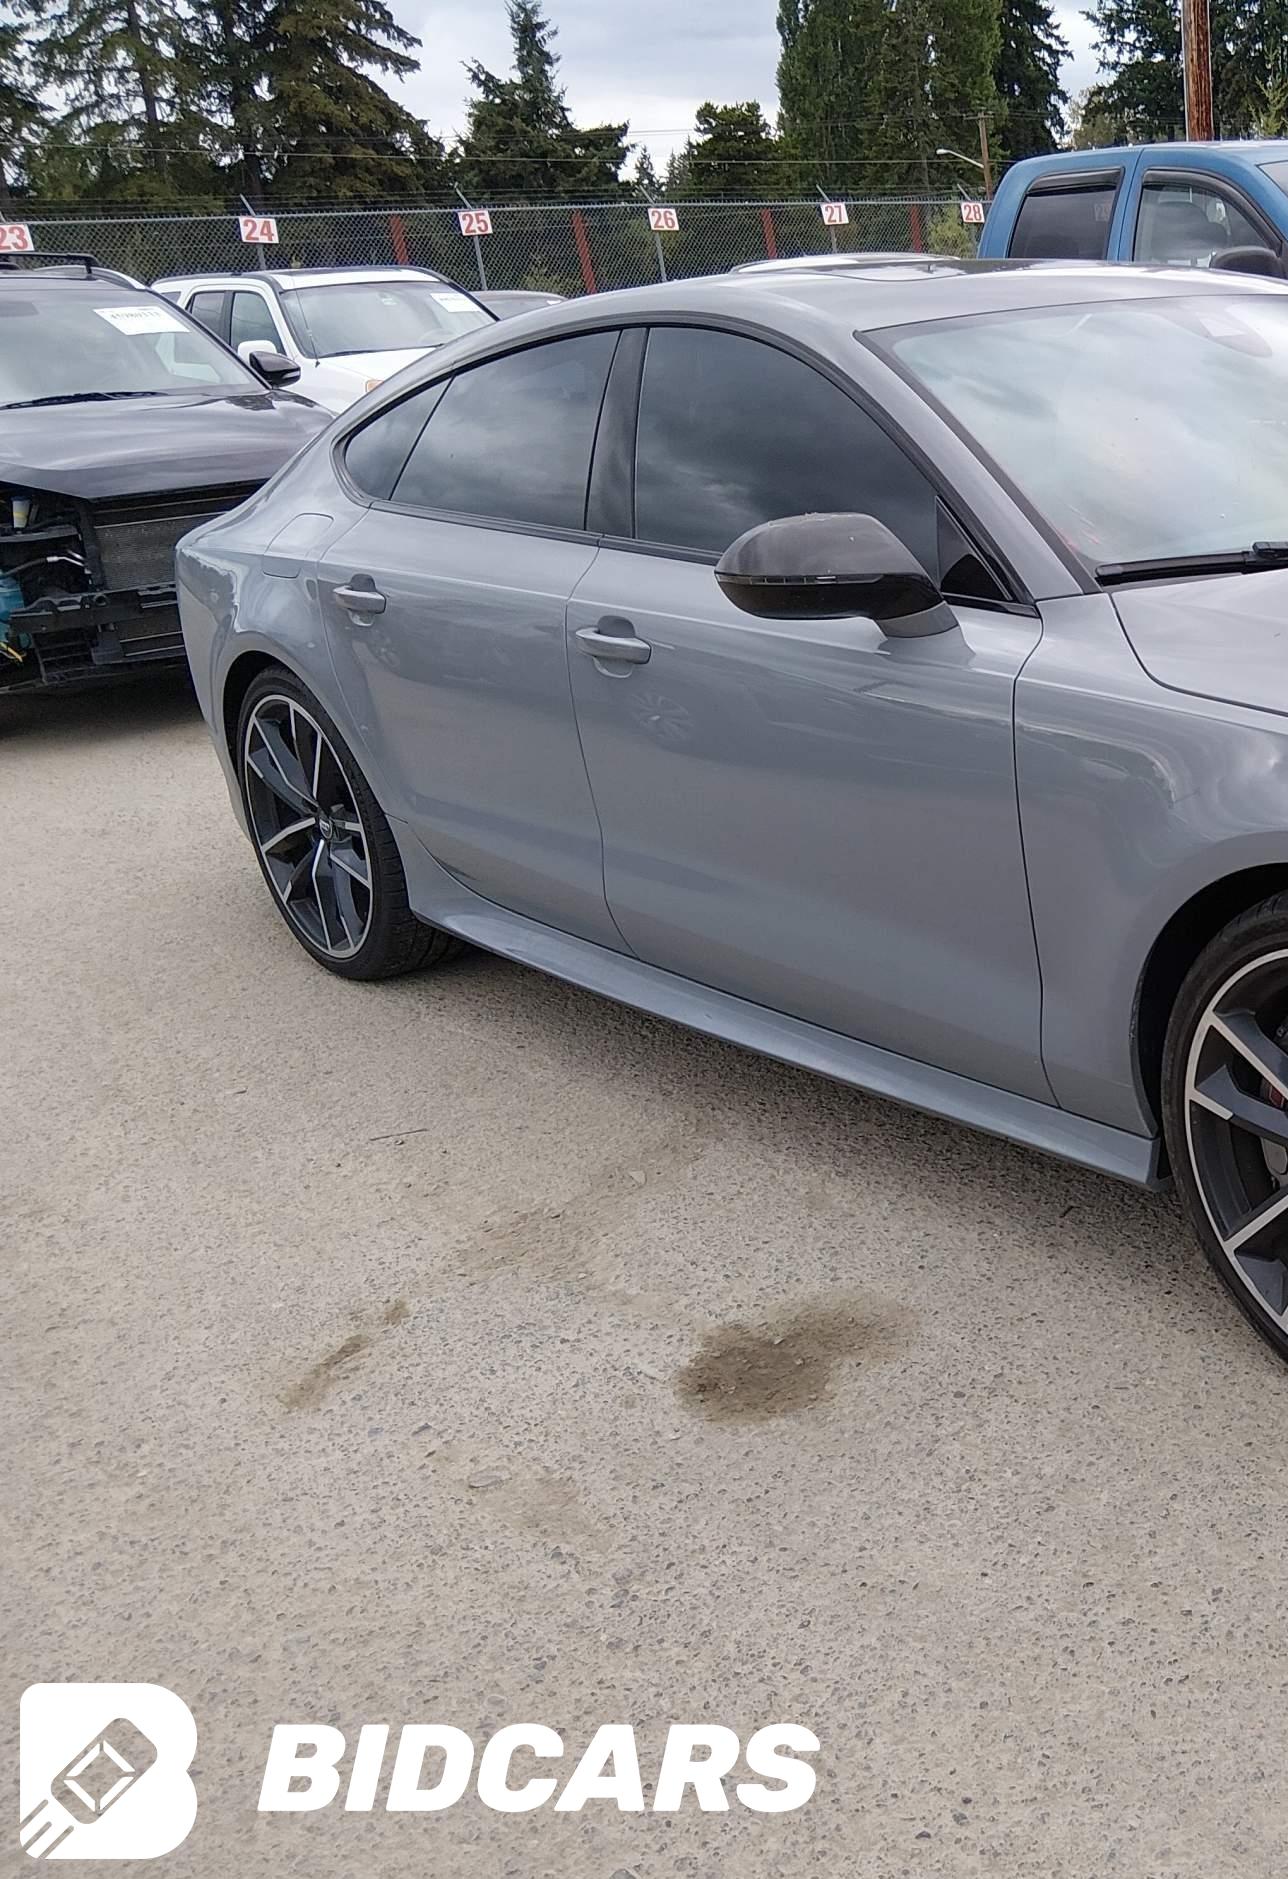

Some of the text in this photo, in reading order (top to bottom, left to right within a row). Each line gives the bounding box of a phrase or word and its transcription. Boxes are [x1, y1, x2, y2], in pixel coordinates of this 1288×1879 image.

[651, 210, 676, 229] 26
[825, 205, 843, 223] 27
[963, 204, 983, 221] 28
[243, 218, 275, 241] 24
[462, 212, 489, 234] 25
